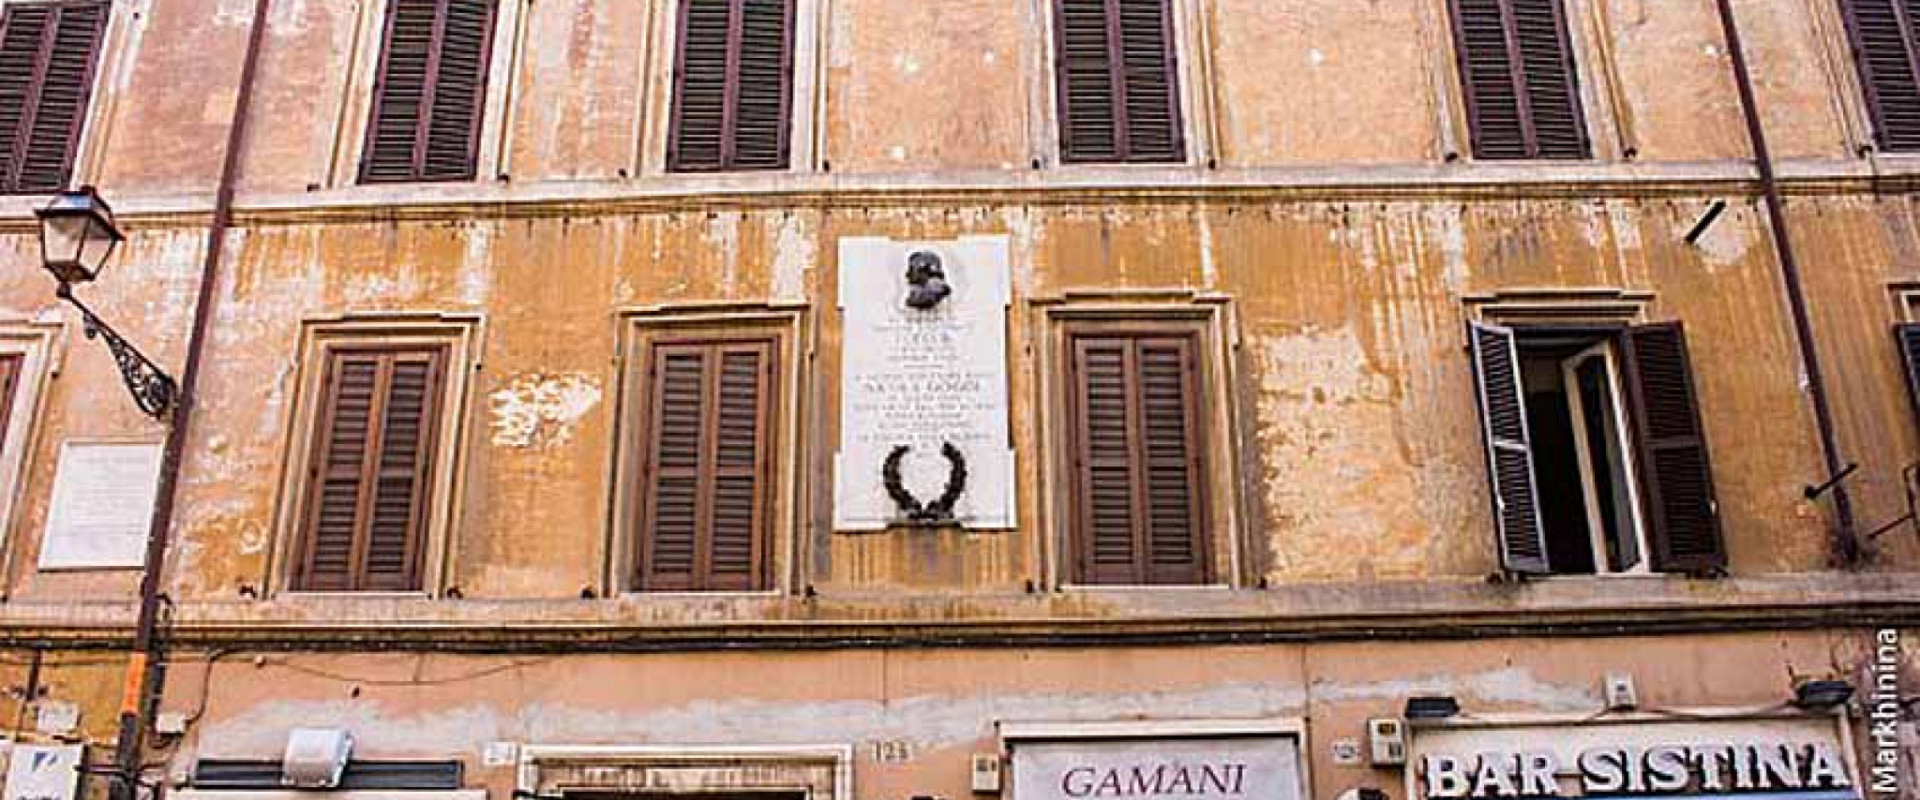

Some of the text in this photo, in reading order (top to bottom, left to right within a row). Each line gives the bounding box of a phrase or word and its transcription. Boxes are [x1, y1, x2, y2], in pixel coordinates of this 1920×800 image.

[1061, 763, 1248, 797] GAMANI
[1425, 743, 1850, 798] BAR SISTINA
